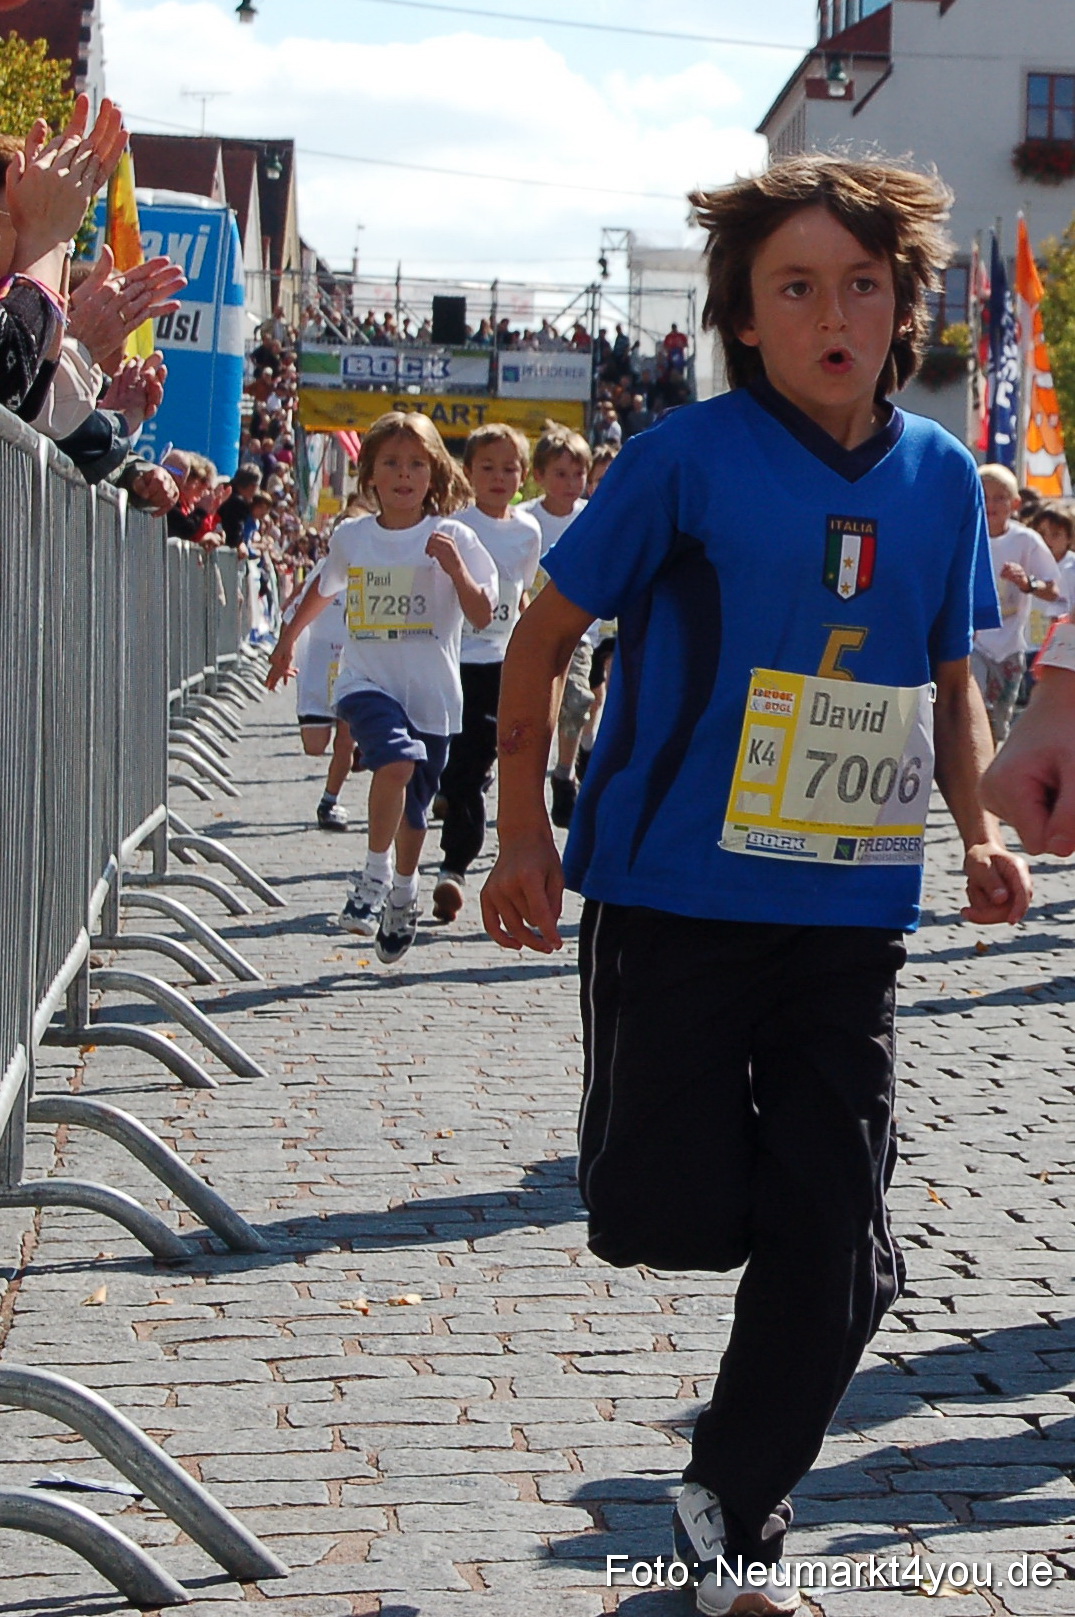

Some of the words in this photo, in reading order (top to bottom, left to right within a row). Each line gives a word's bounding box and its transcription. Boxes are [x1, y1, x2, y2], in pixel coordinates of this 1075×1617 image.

[93, 224, 211, 281] axi
[342, 354, 451, 379] BOCK
[392, 400, 490, 426] START
[829, 518, 875, 535] ITALIA
[366, 571, 391, 587] Paul
[368, 594, 427, 616] 7283
[808, 691, 889, 734] David
[746, 737, 777, 768] K4
[804, 748, 923, 806] 7006
[746, 831, 806, 851] BOCK
[857, 836, 922, 853] PFLEIDERER
